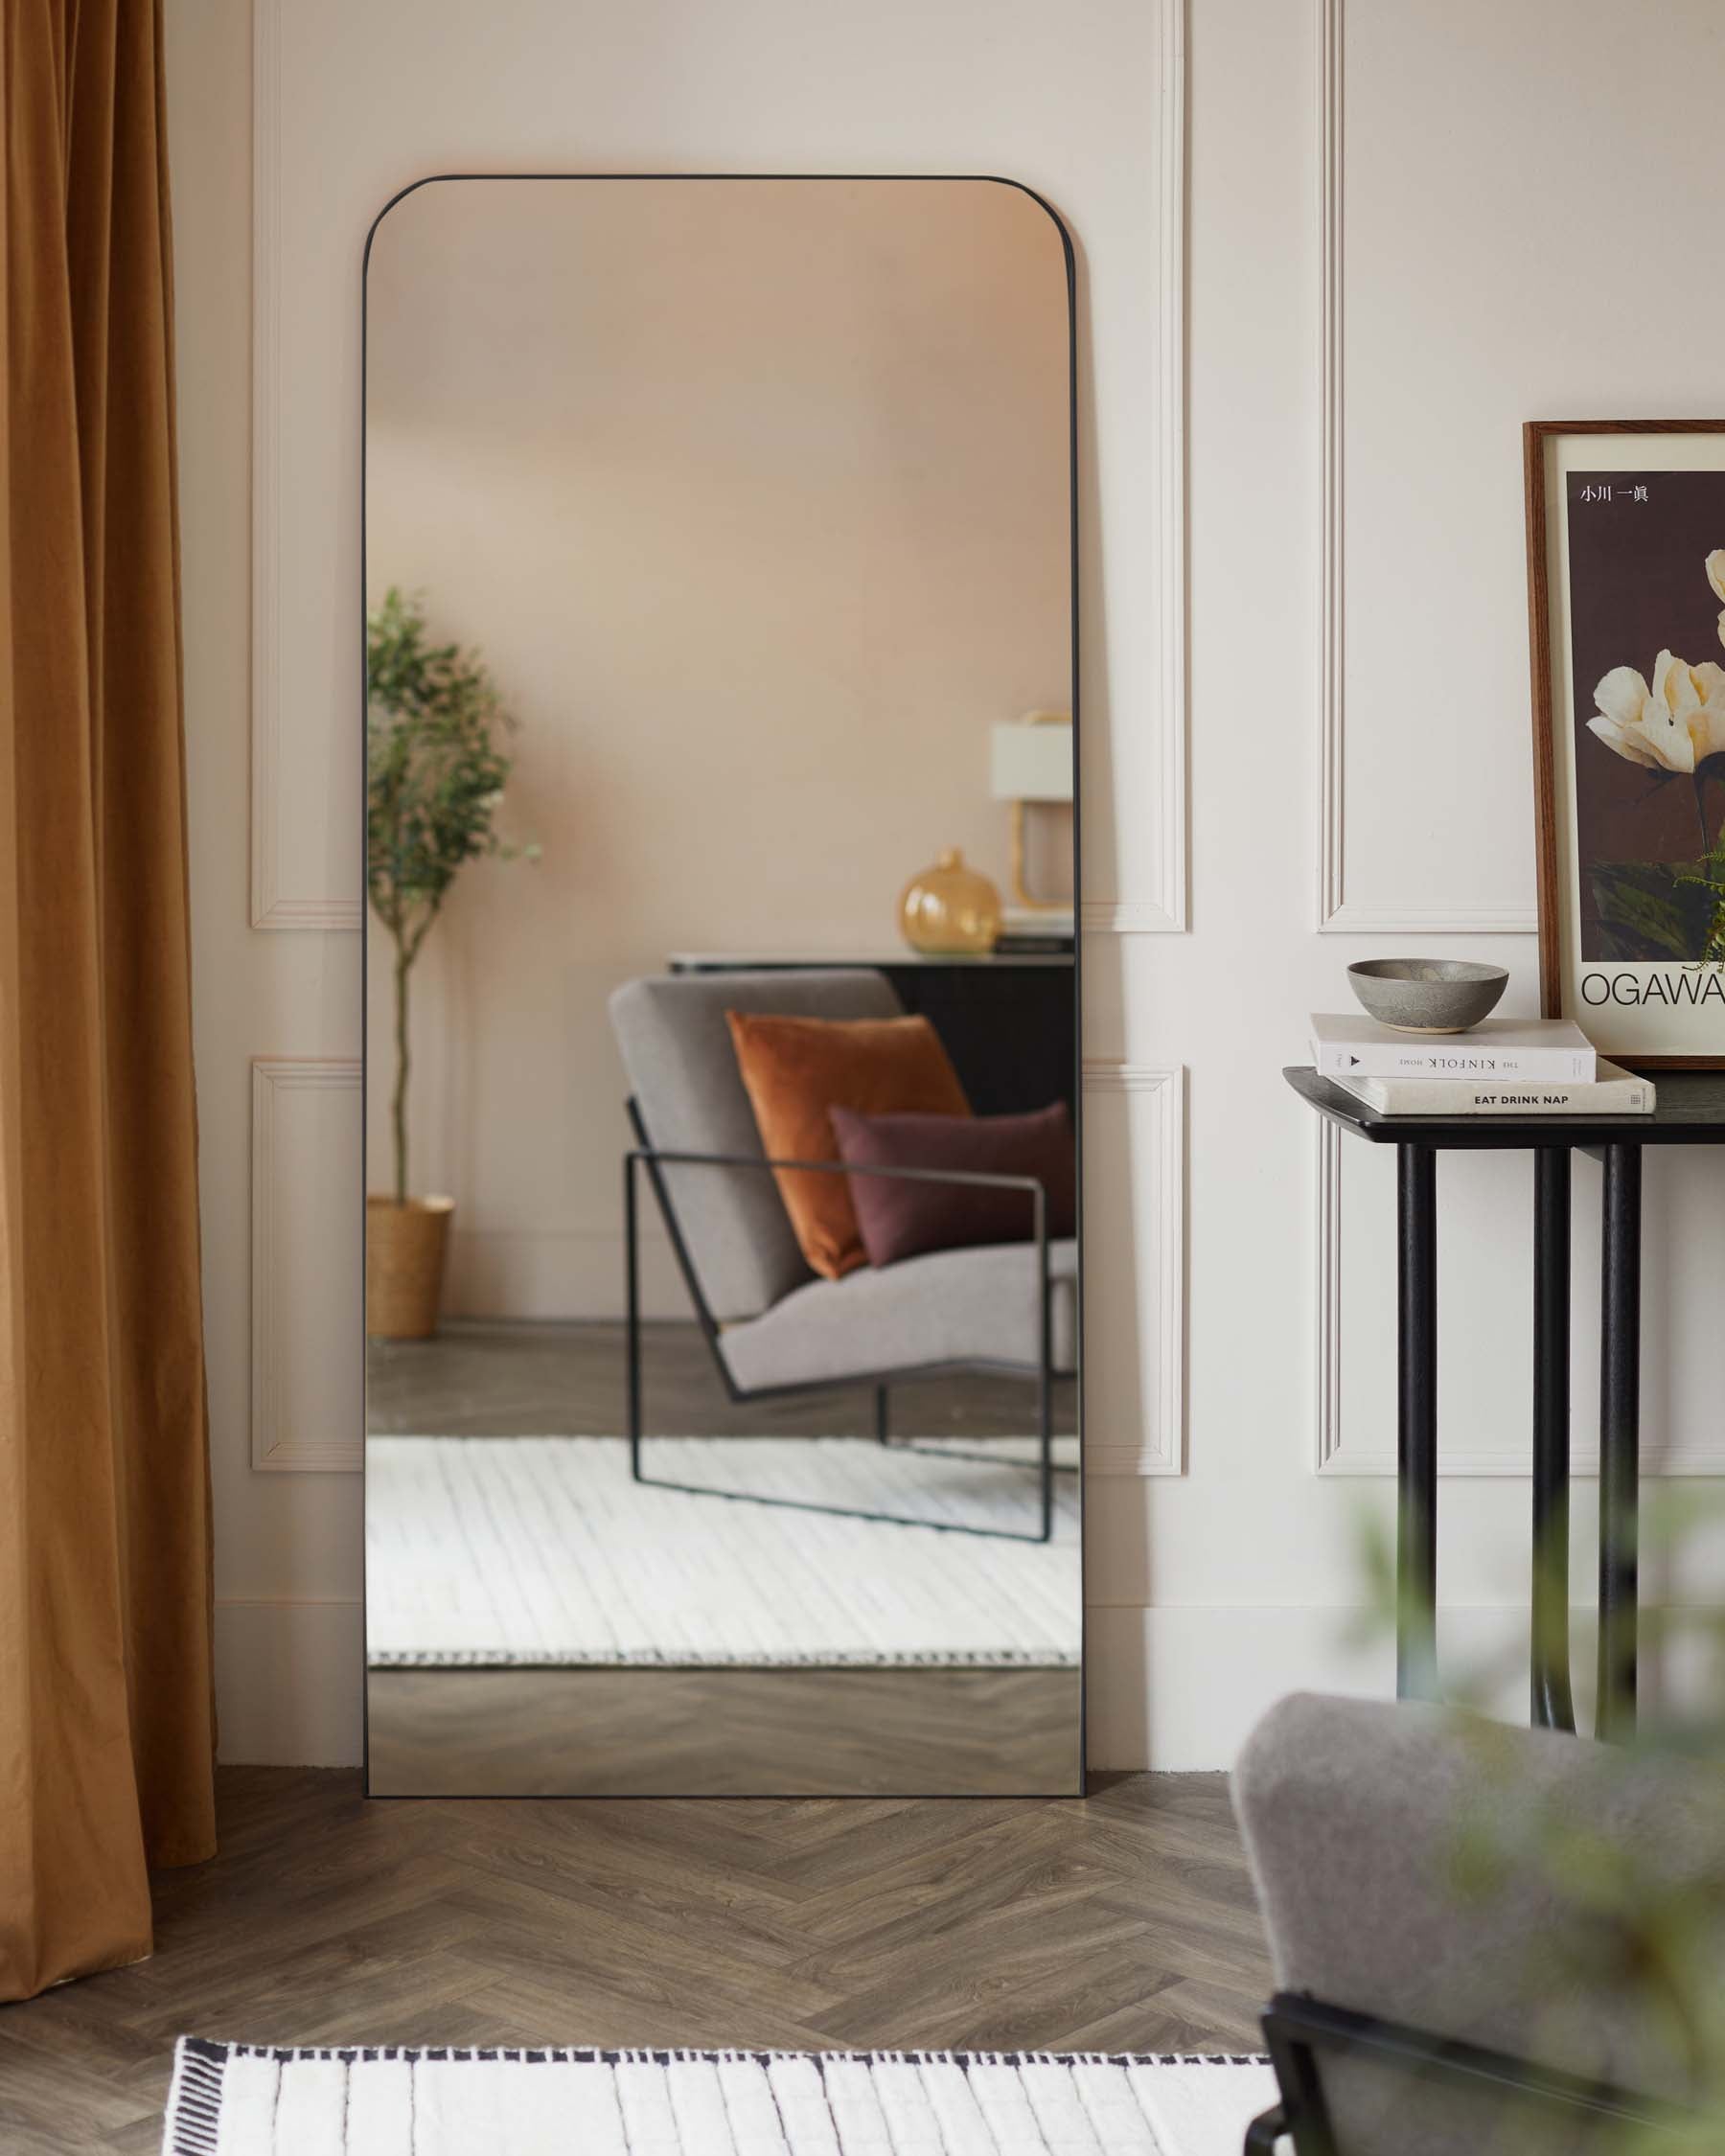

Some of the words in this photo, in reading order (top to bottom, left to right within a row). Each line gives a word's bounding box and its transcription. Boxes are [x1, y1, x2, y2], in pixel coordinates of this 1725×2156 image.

[1581, 973, 1725, 1006] OGAWA
[1398, 1058, 1423, 1067] HOME
[1428, 1058, 1495, 1069] KINFOLK
[1474, 1095, 1497, 1105] EAT
[1501, 1095, 1539, 1105] DRINK
[1543, 1095, 1569, 1105] NAP
